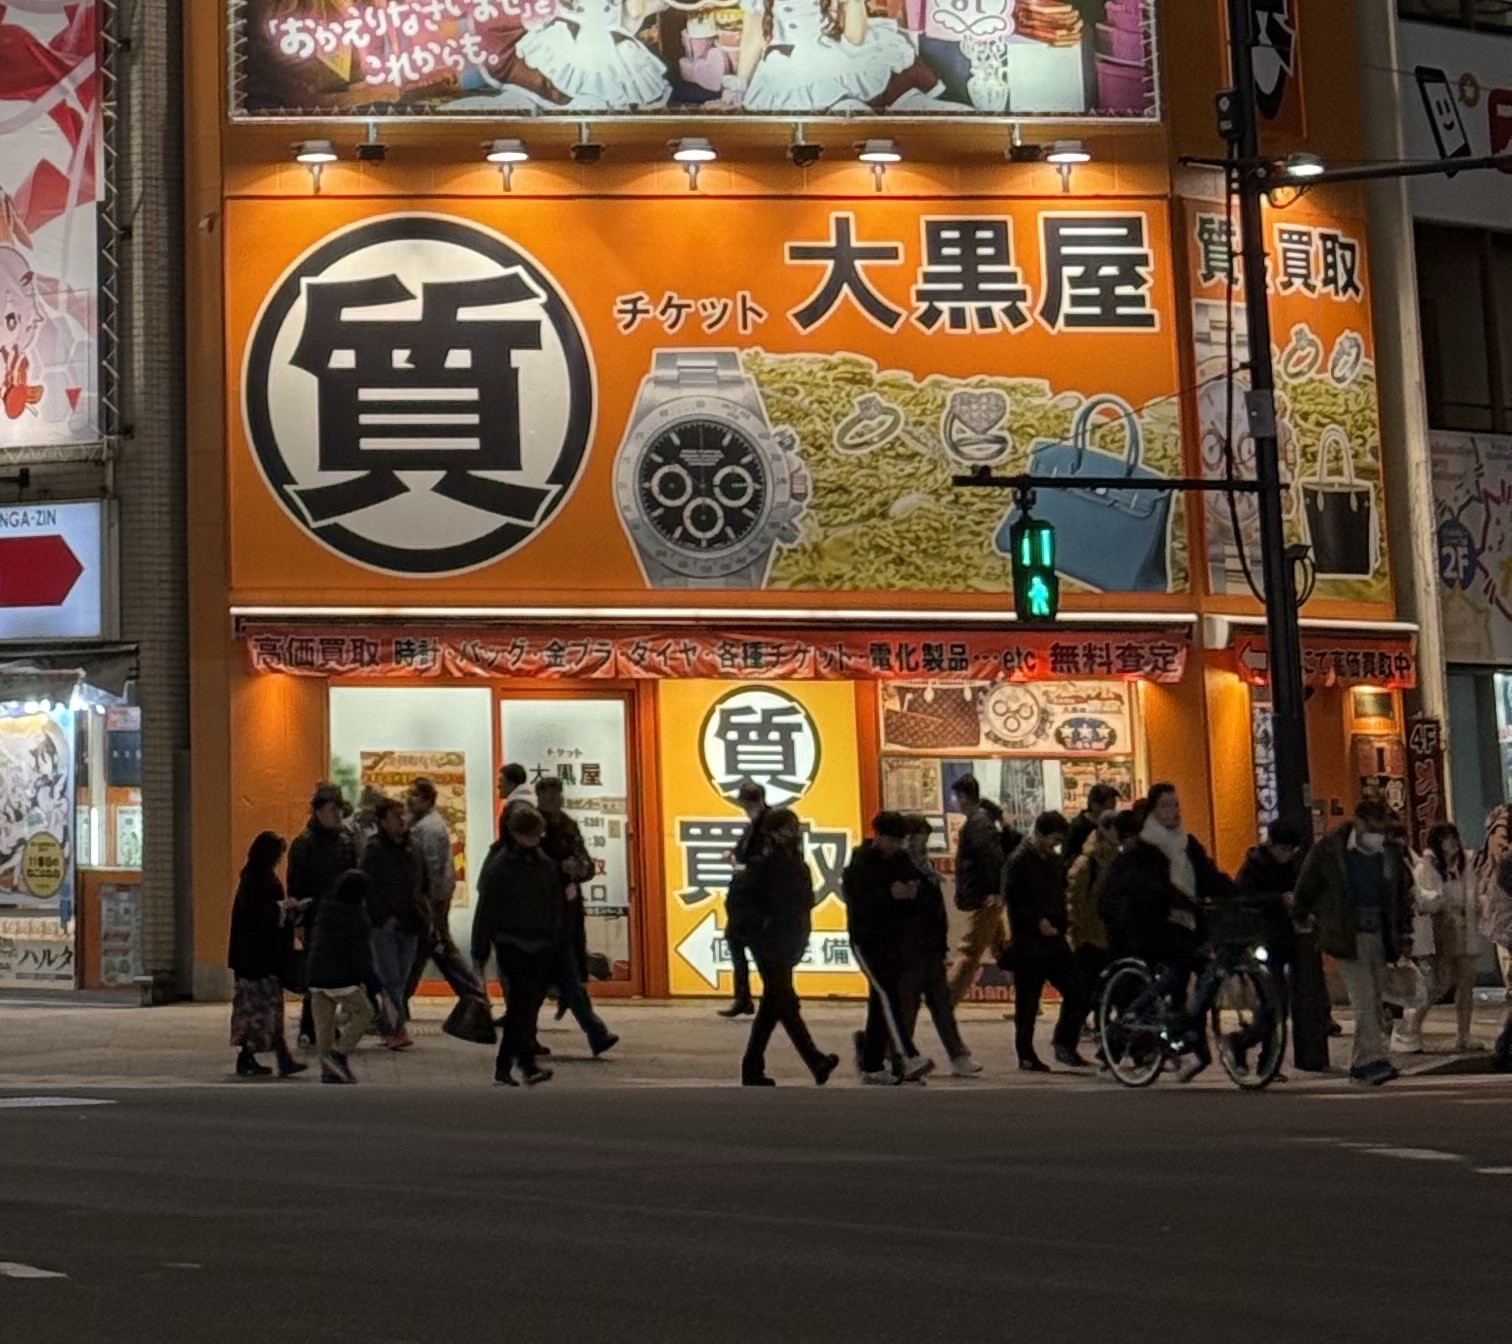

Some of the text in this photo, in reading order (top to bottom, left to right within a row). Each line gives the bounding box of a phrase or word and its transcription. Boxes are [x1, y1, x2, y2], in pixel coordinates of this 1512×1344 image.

[366, 34, 499, 87] これからも。
[616, 210, 1160, 335] チケット 大黒屋
[1276, 224, 1364, 301] 買取
[284, 274, 554, 529] 質
[1441, 543, 1470, 581] 2F
[253, 635, 1181, 676] 高価買取 無料査定
[714, 705, 811, 795] 質
[1410, 723, 1437, 754] 4F
